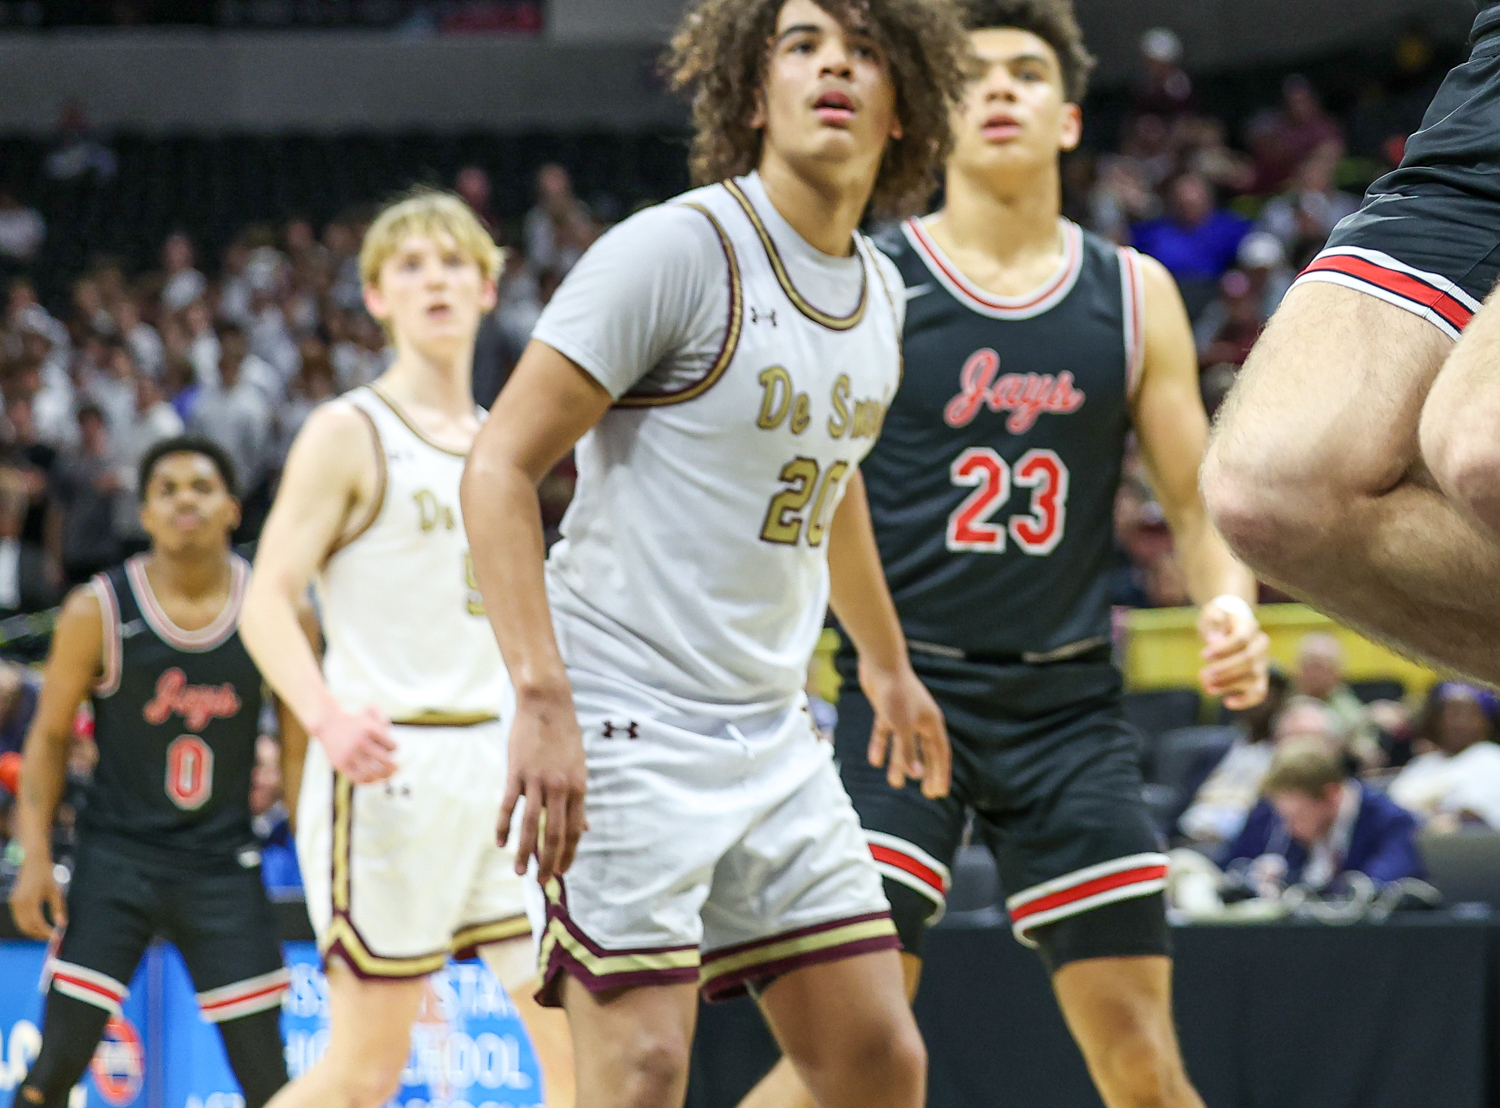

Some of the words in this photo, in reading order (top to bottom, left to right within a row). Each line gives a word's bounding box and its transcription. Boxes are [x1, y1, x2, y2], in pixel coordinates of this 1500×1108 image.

[757, 365, 811, 436] De
[943, 347, 1086, 435] Jays
[760, 454, 850, 548] 20
[945, 446, 1070, 557] 23
[164, 733, 215, 811] 0
